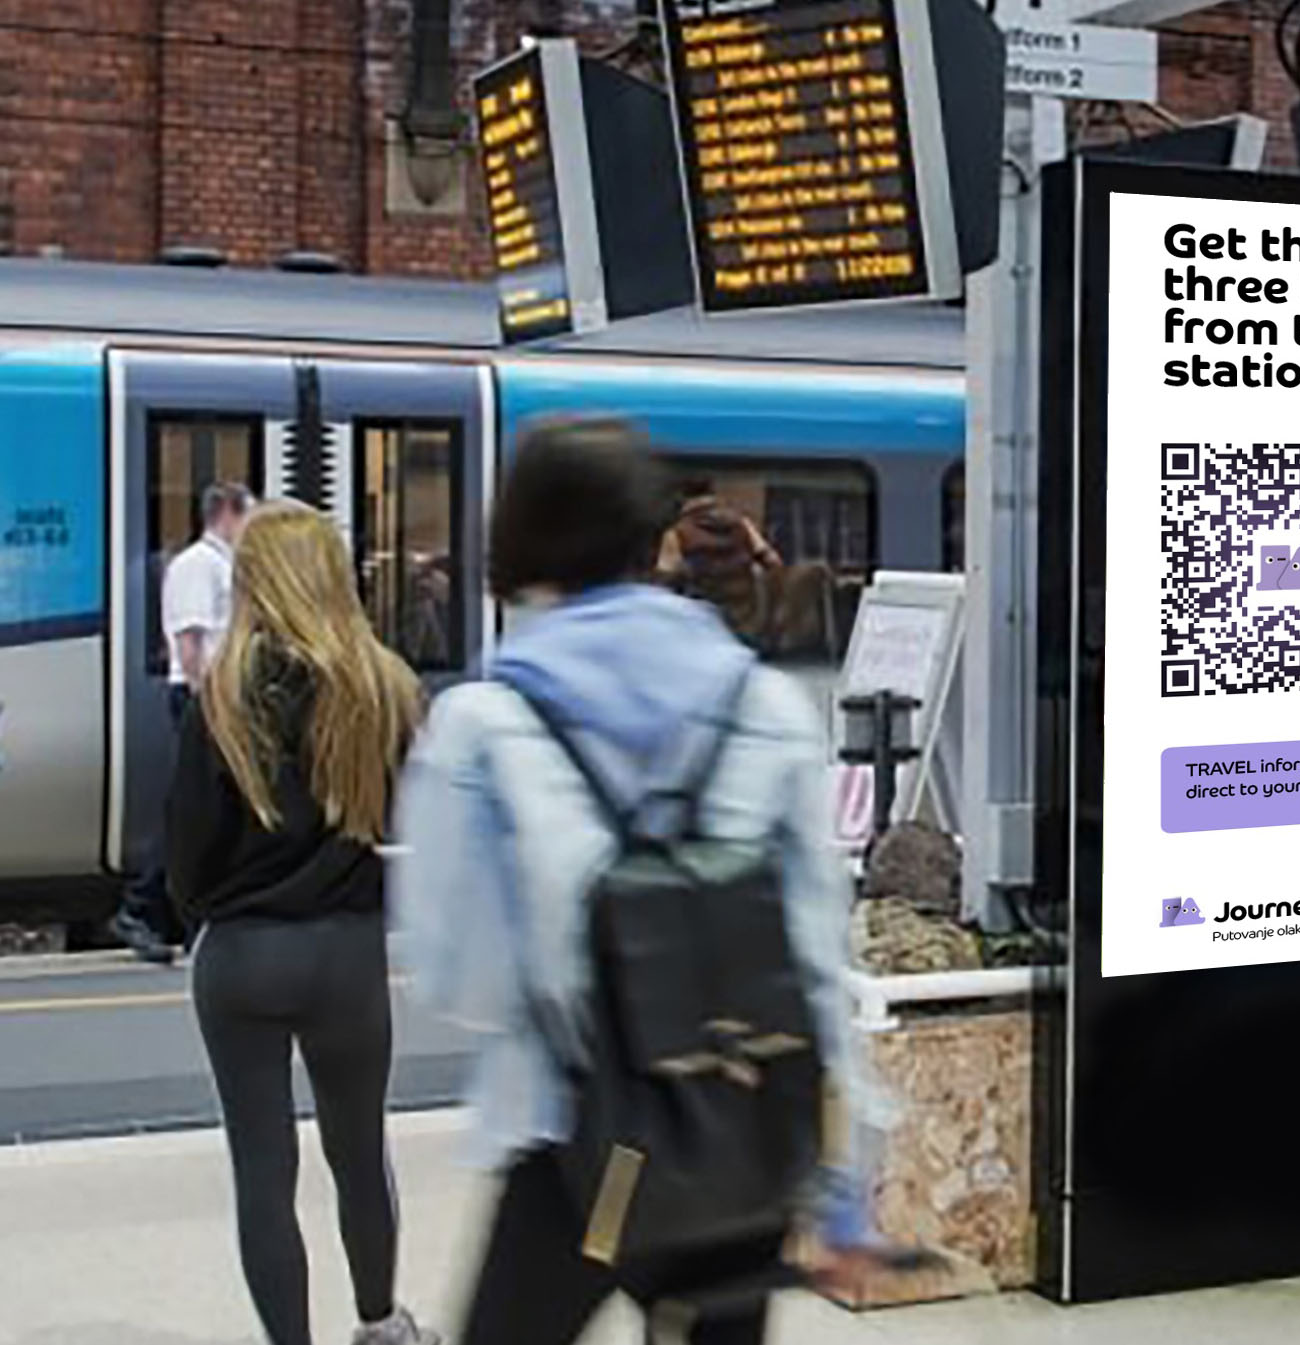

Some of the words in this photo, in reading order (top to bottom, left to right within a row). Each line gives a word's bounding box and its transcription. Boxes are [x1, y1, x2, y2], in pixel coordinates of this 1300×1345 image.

[1072, 32, 1081, 52] 1
[1069, 68, 1084, 89] 2
[1164, 223, 1248, 260] Get
[1164, 264, 1289, 304] three
[1164, 307, 1278, 346] from
[1185, 760, 1257, 777] TRAVEL
[1185, 783, 1236, 800] direct
[1239, 783, 1259, 796] to
[1212, 927, 1275, 942] Putovanje
